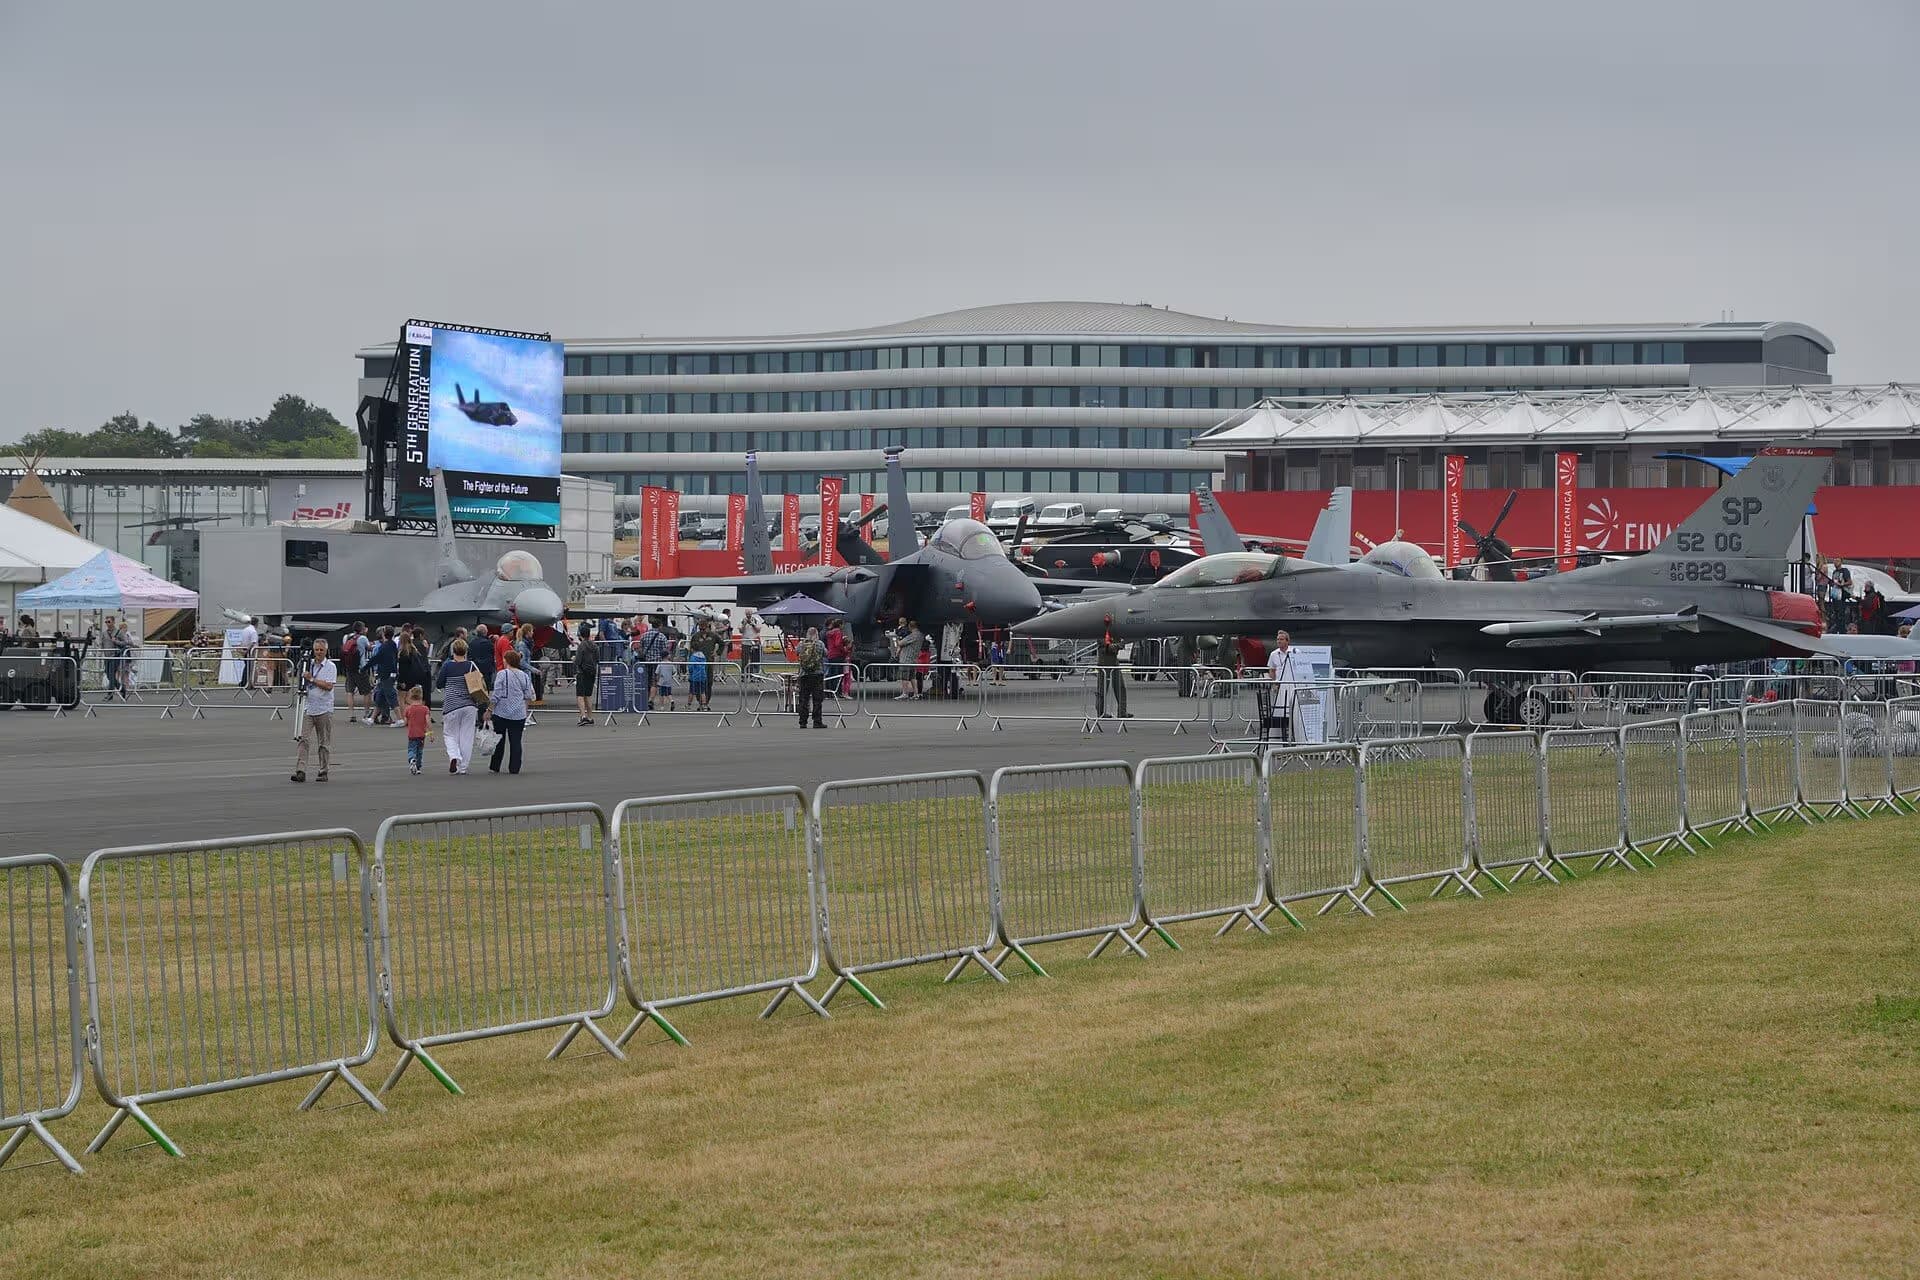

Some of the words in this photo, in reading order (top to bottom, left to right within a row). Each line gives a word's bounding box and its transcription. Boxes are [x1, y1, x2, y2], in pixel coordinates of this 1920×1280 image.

[407, 348, 420, 431] GENERATION
[418, 376, 430, 432] FIGHTER
[407, 434, 423, 463] 5TH
[419, 476, 433, 488] F-35
[462, 480, 474, 491] The
[474, 480, 494, 494] Fighter
[495, 482, 501, 493] of
[501, 483, 510, 493] the
[511, 484, 529, 495] Future
[1722, 497, 1763, 526] SP
[1563, 490, 1572, 564] FNMECCANICA
[1677, 533, 1704, 552] 52
[1715, 533, 1742, 552] OG
[1670, 562, 1683, 571] AF
[1685, 561, 1727, 581] 829
